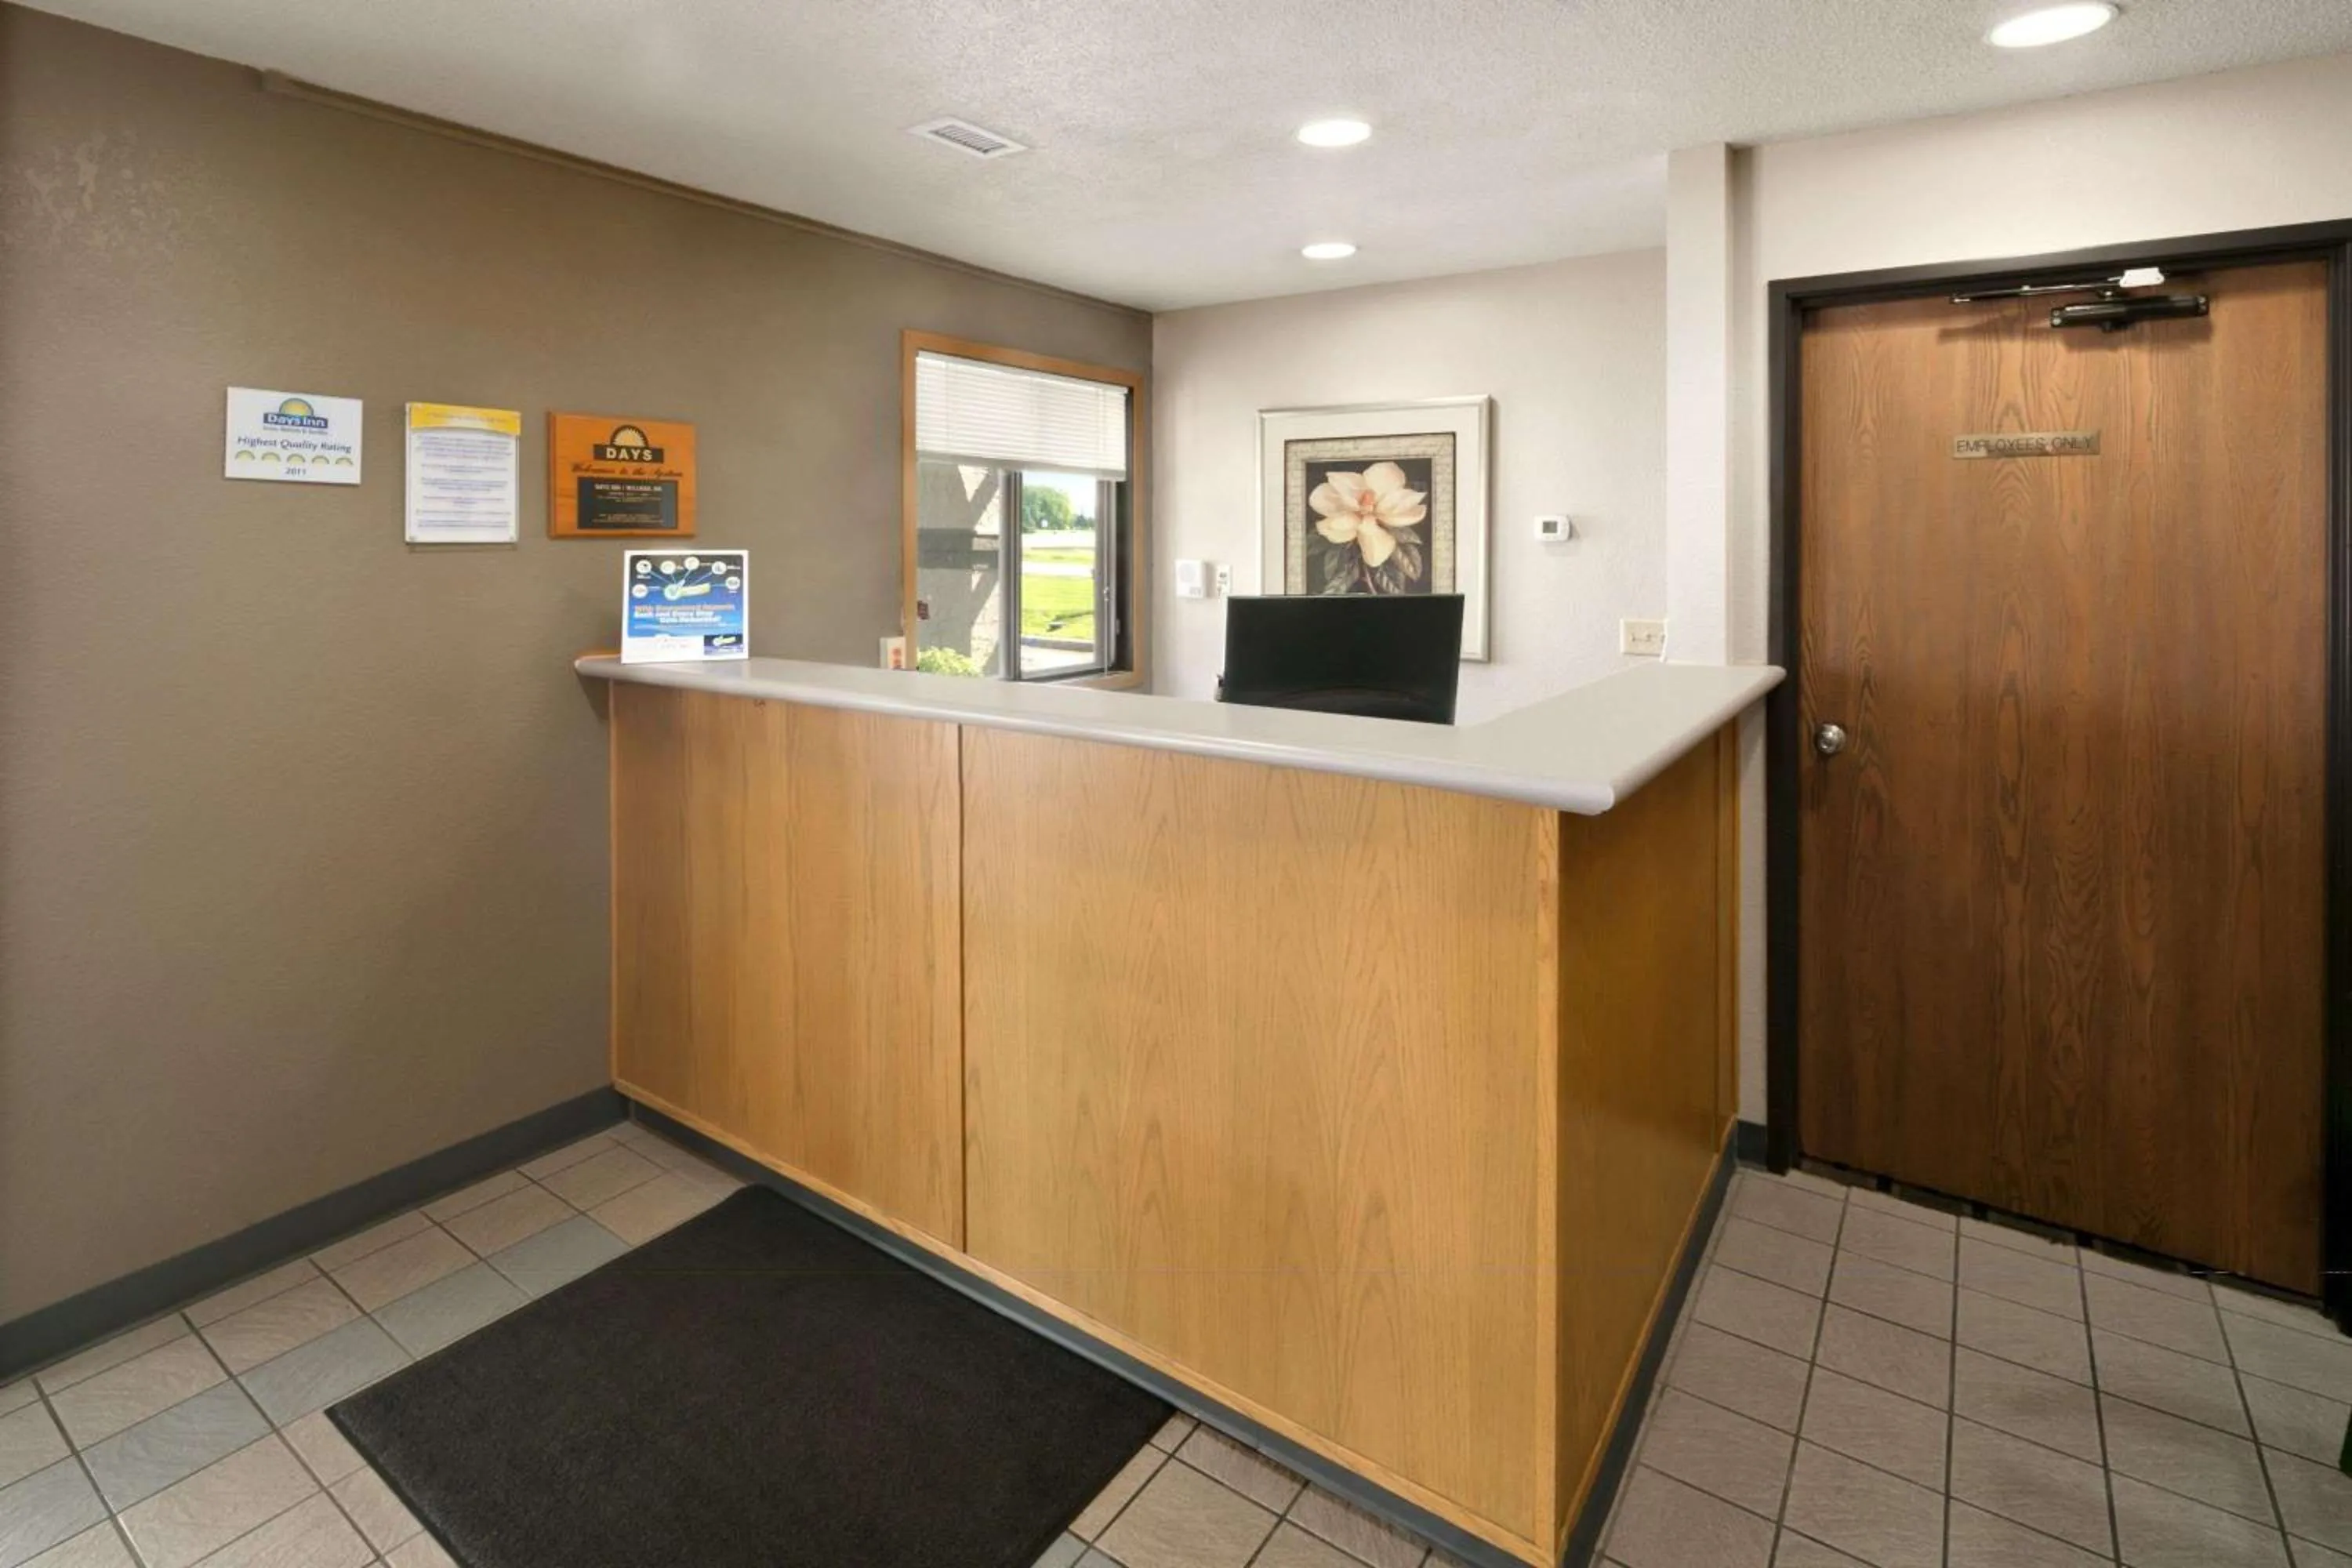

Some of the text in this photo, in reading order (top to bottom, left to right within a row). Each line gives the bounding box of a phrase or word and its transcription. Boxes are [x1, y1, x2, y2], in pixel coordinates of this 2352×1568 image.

[303, 417, 327, 427] Inn
[238, 436, 352, 454] Highest Quality Rating
[1956, 436, 2094, 452] EMPLOYEES ONLY
[605, 448, 653, 462] DAYS
